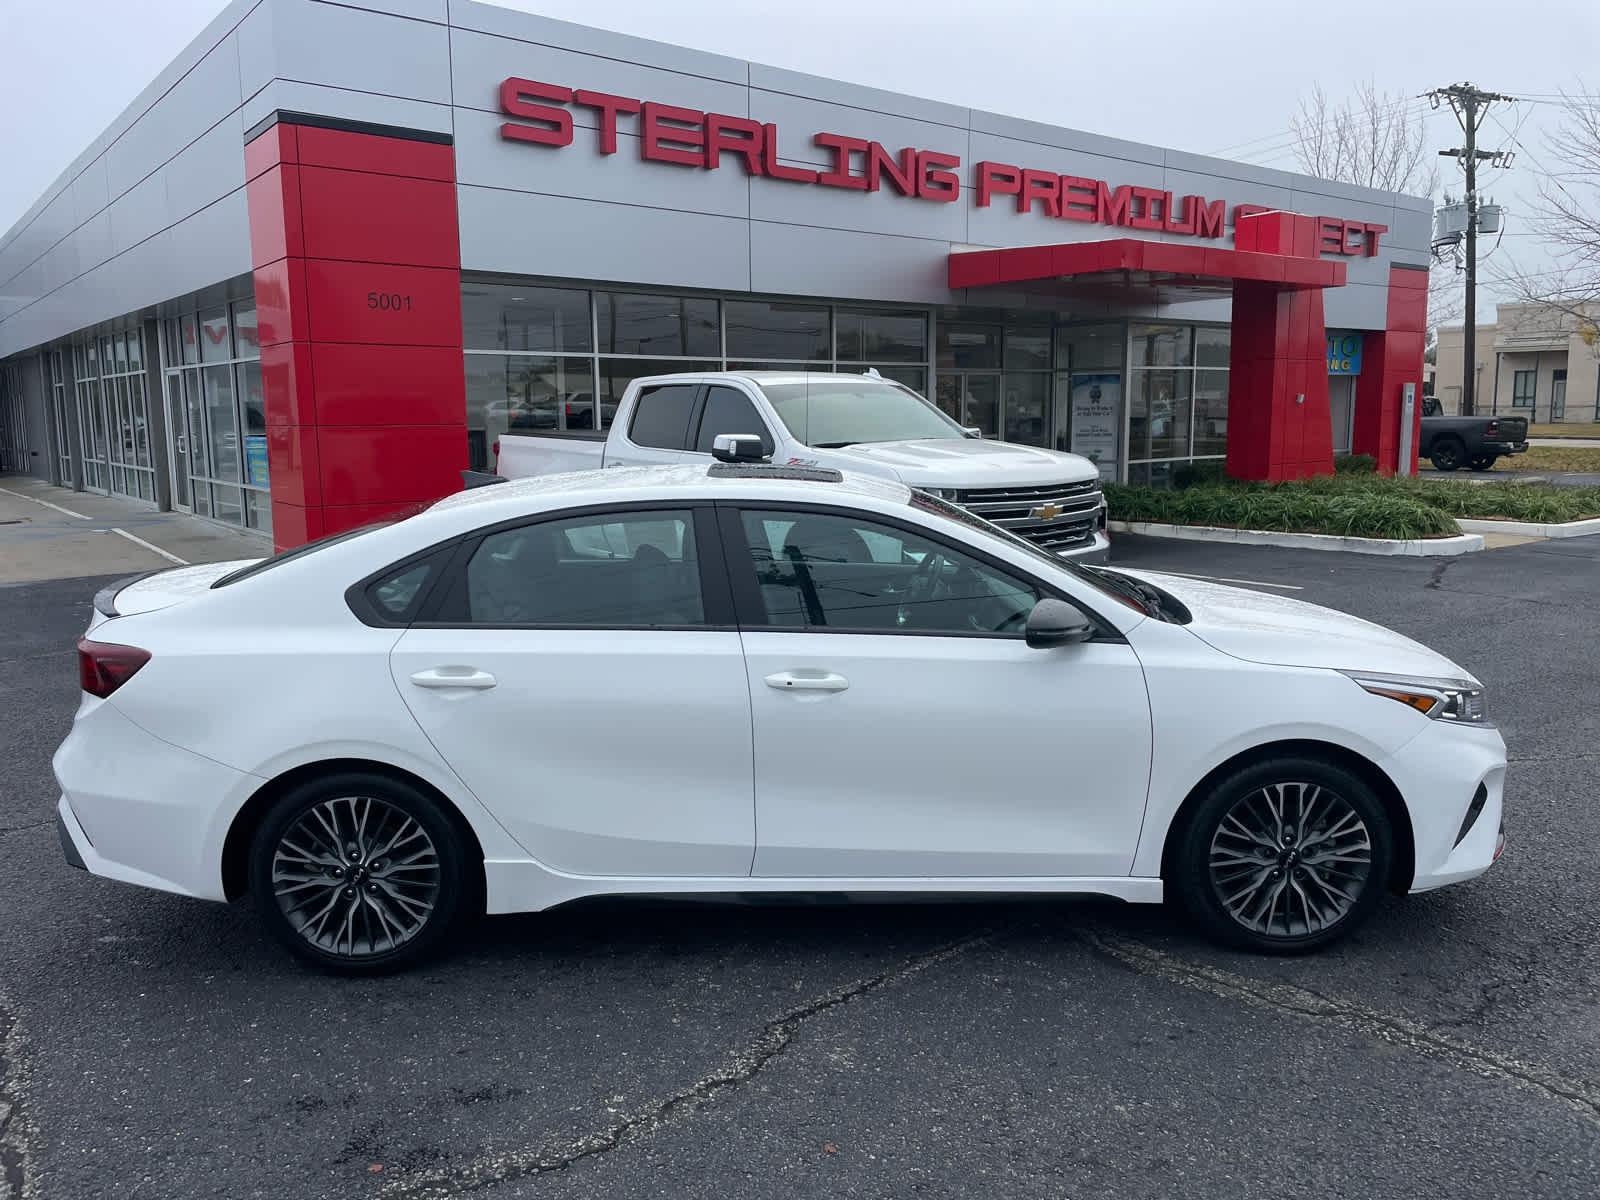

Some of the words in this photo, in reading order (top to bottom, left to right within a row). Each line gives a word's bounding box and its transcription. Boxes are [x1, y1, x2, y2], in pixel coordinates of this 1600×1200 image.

[499, 76, 961, 202] STERLING
[976, 161, 1226, 238] PREMIUM
[367, 291, 411, 312] 5001
[1328, 336, 1359, 357] TO
